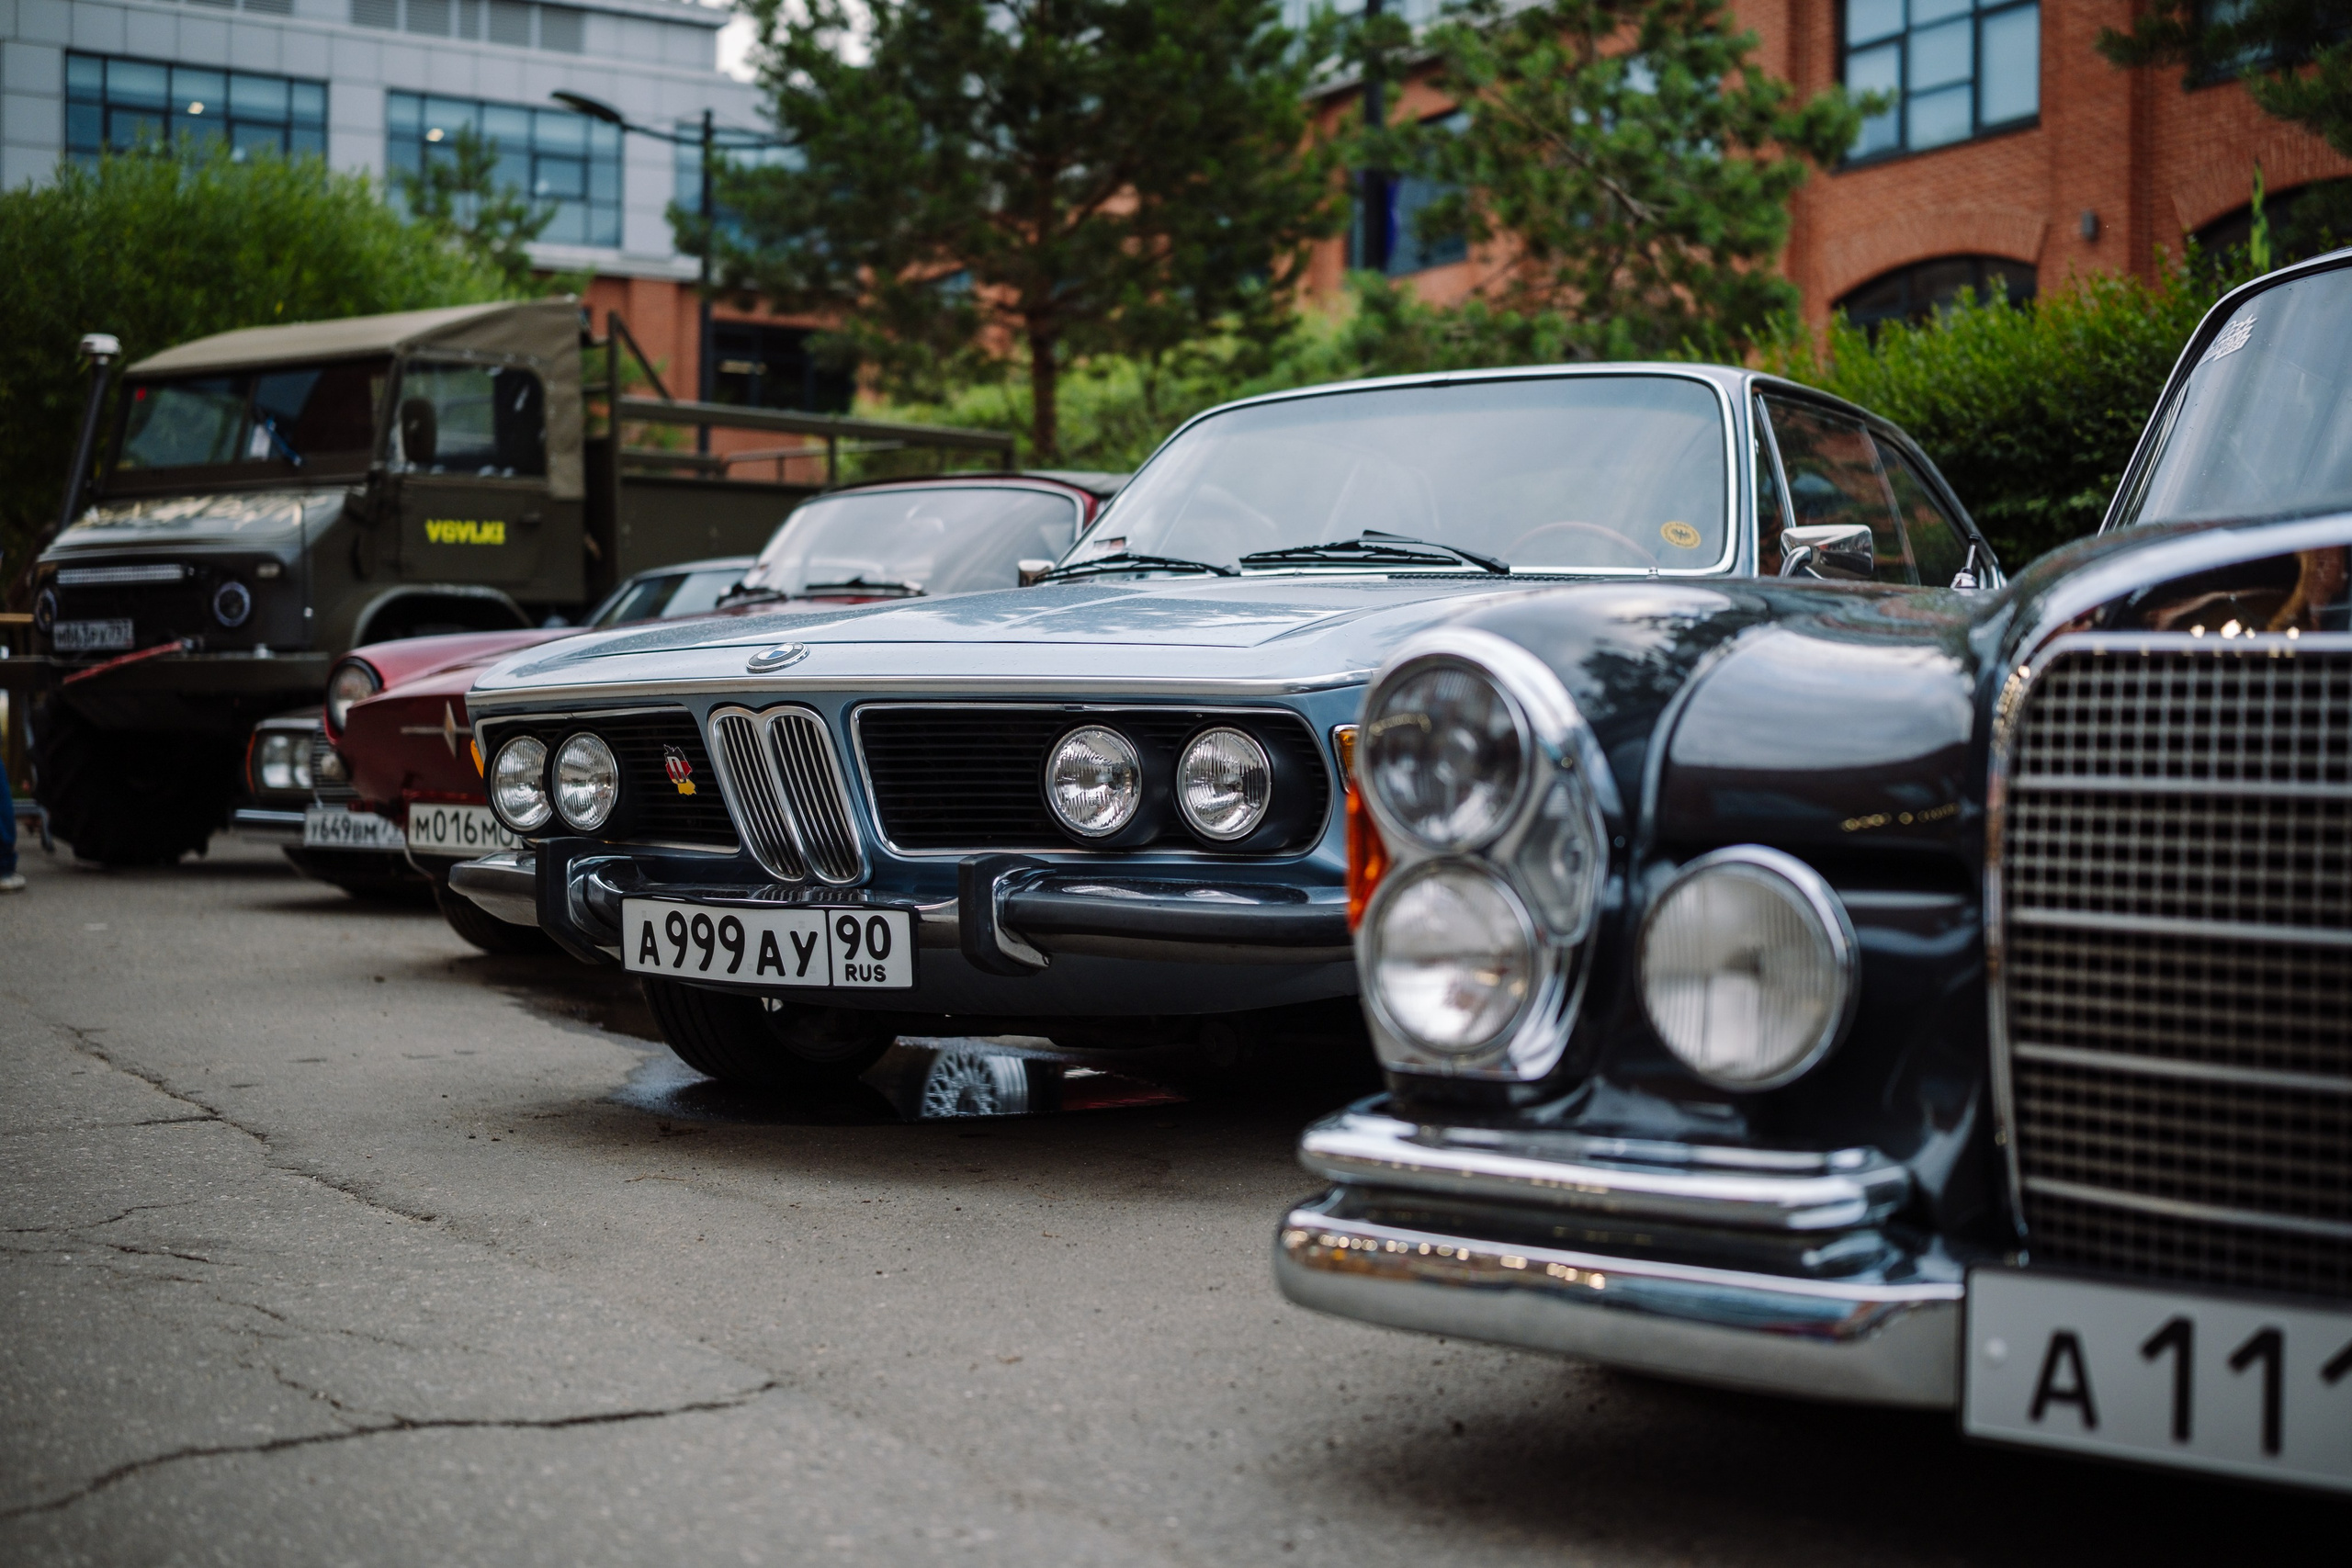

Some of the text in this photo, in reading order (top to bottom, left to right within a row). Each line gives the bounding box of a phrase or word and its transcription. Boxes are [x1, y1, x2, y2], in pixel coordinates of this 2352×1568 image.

[639, 910, 891, 976] А999АУ 90
[844, 963, 887, 982] RUS
